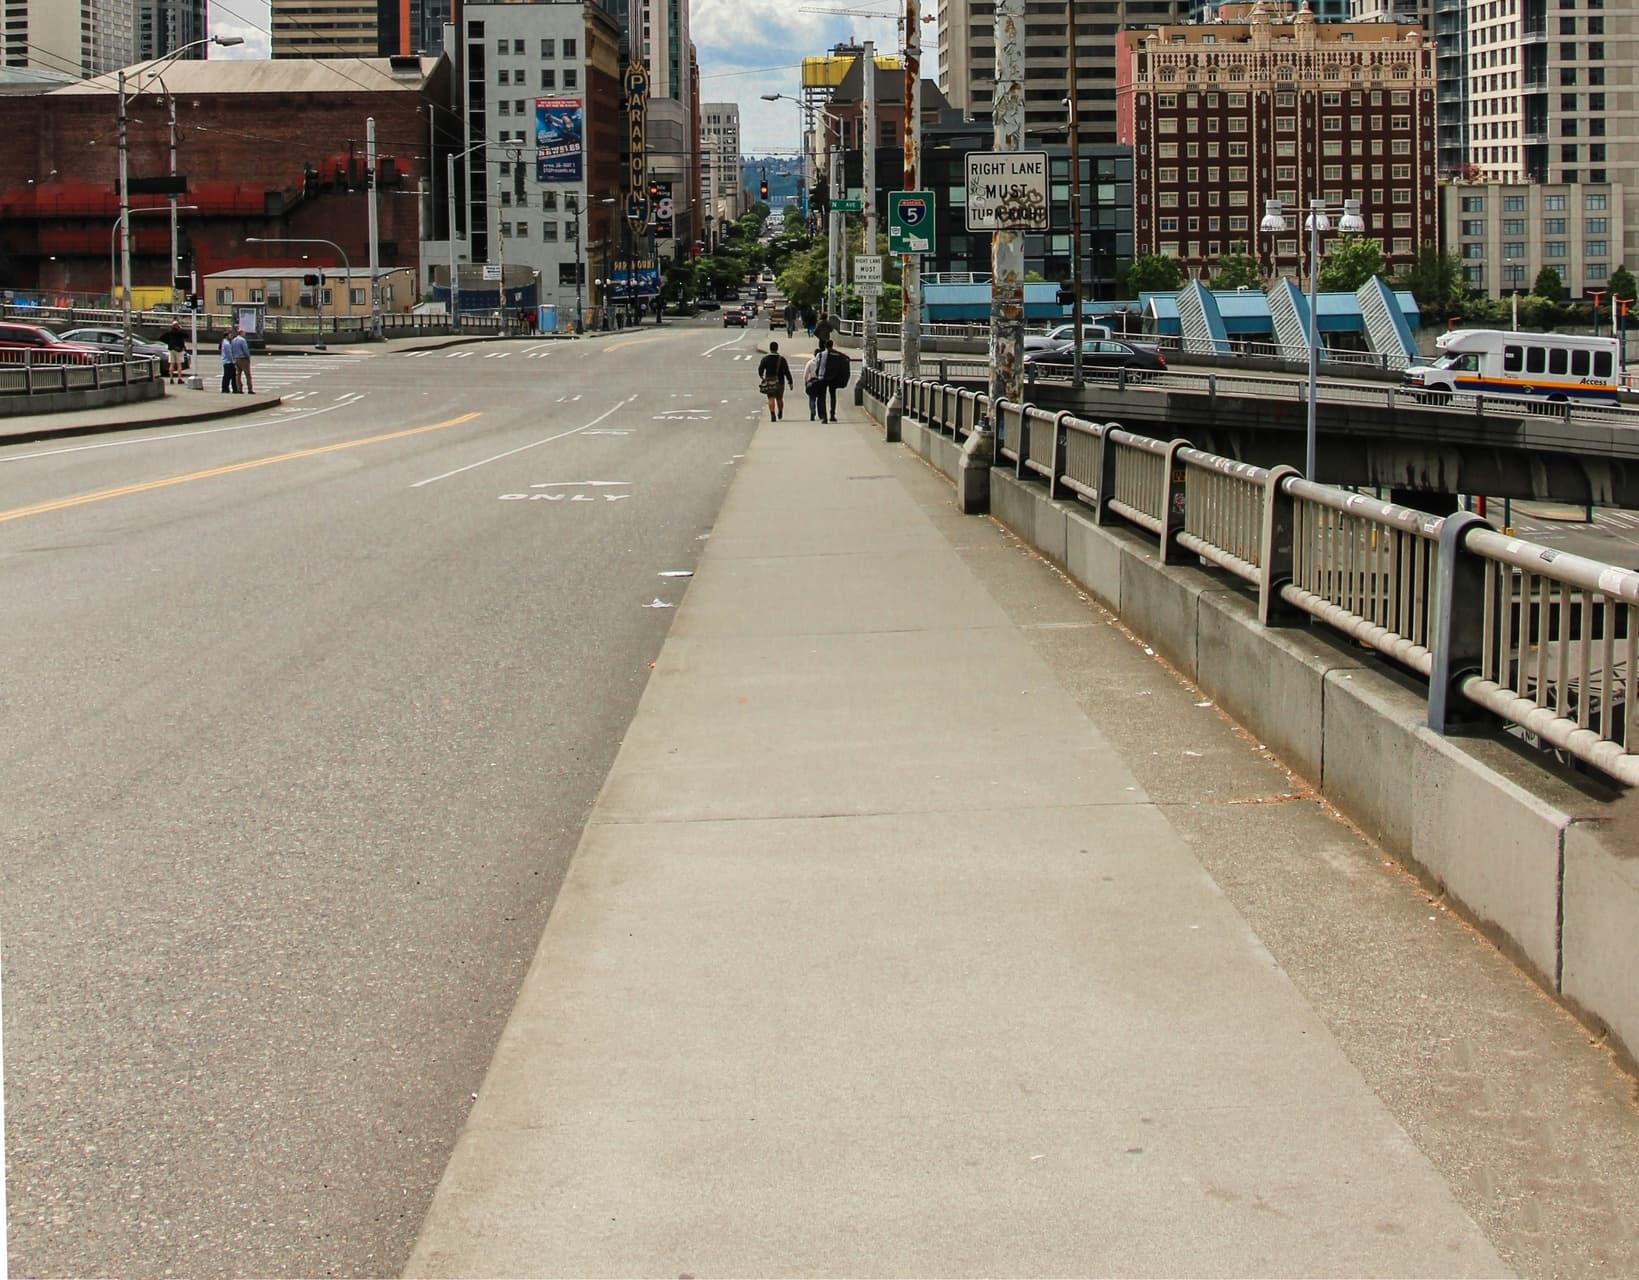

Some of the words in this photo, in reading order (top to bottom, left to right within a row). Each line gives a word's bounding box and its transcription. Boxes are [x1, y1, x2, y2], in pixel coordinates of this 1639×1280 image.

[631, 75, 644, 218] PARAMOUNT
[971, 163, 1005, 175] RIGHT
[1012, 162, 1042, 174] LANE
[986, 184, 1027, 199] MUST
[907, 207, 918, 223] 5
[971, 208, 1001, 221] TURN
[1579, 377, 1607, 386] Access
[497, 494, 632, 502] ONLY
